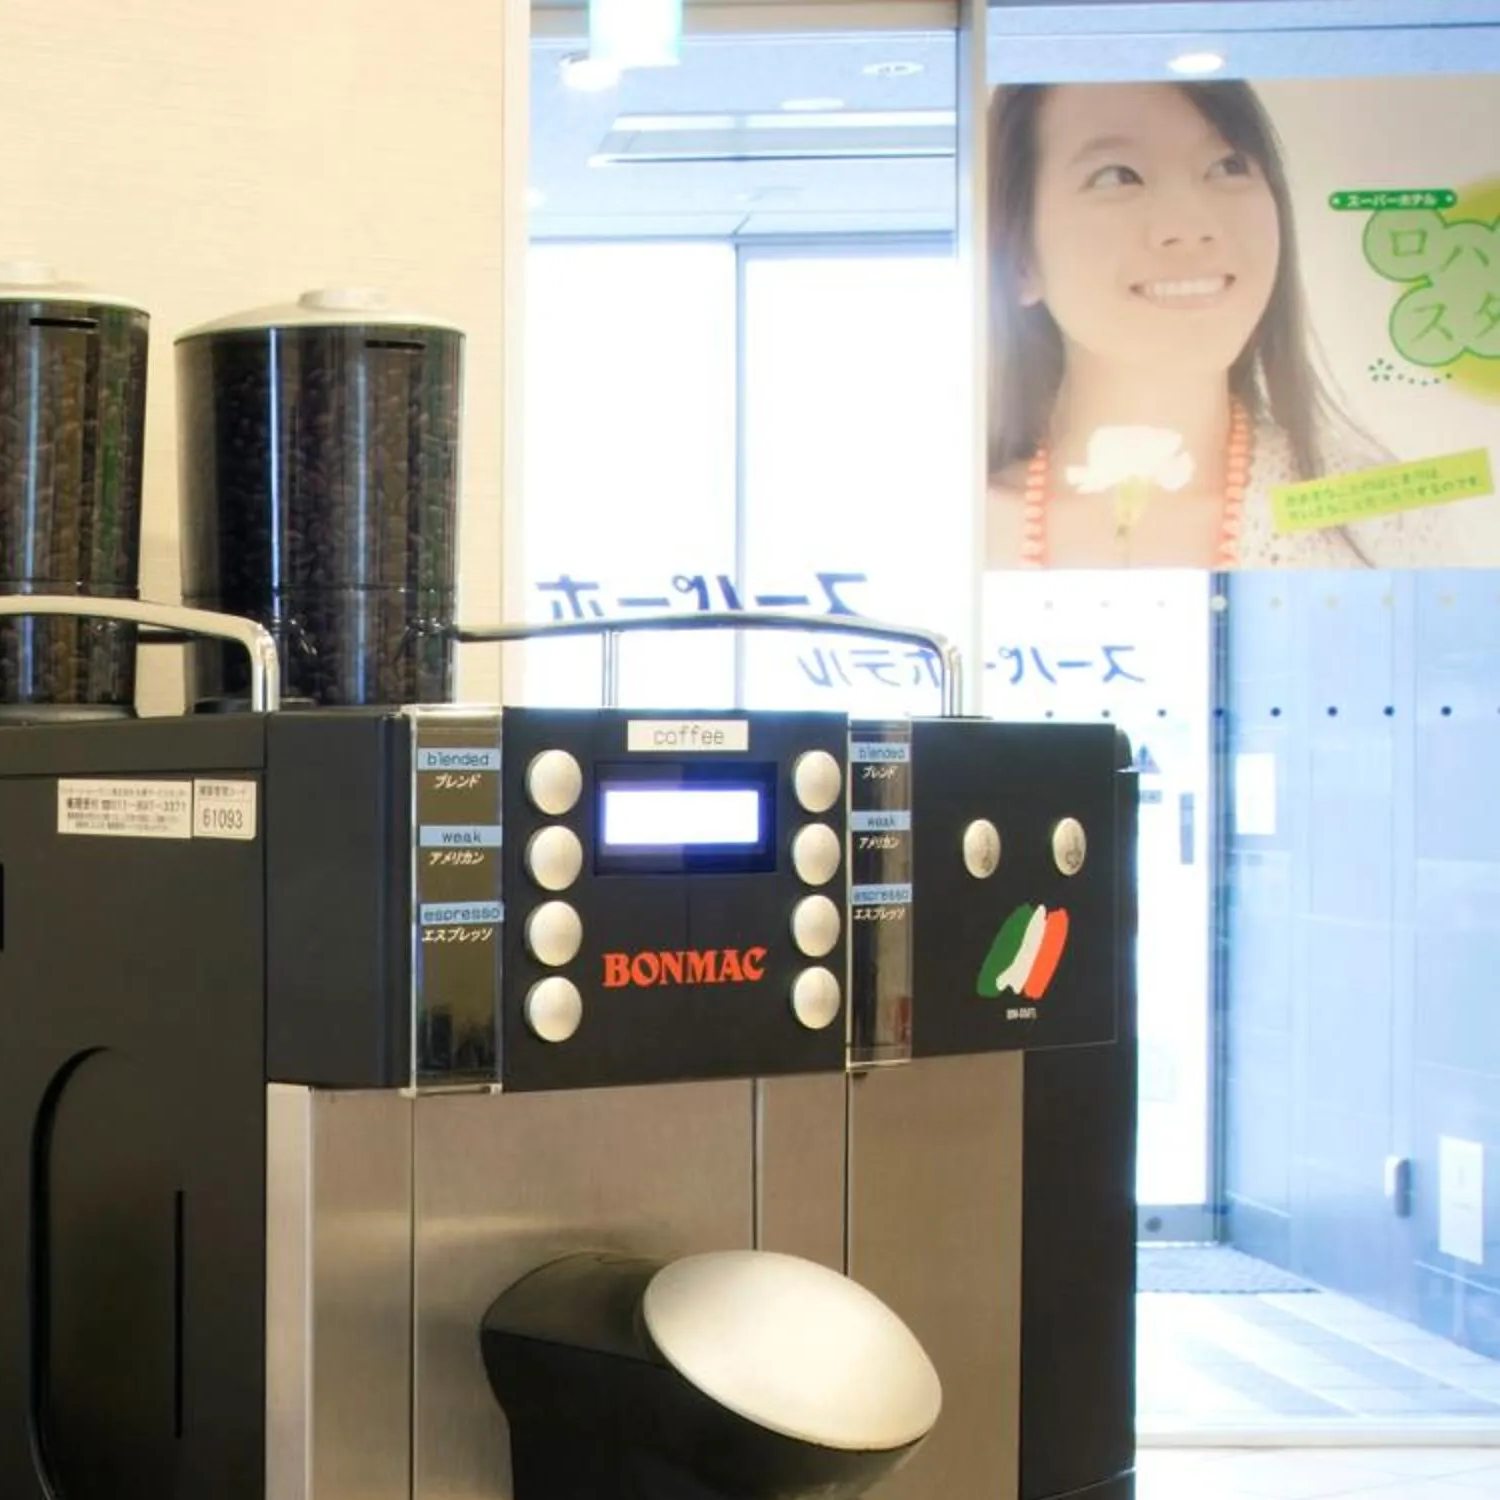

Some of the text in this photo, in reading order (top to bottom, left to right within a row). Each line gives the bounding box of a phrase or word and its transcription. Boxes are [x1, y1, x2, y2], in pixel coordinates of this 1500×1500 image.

[653, 724, 725, 746] coffee
[426, 751, 490, 767] blended
[432, 773, 482, 789] ブレンド
[202, 808, 244, 830] 61093
[441, 830, 482, 844] weak
[427, 851, 485, 866] アメリカン
[422, 905, 501, 924] espresso
[421, 927, 494, 943] エスプレッソ
[602, 946, 769, 989] BONMAC
